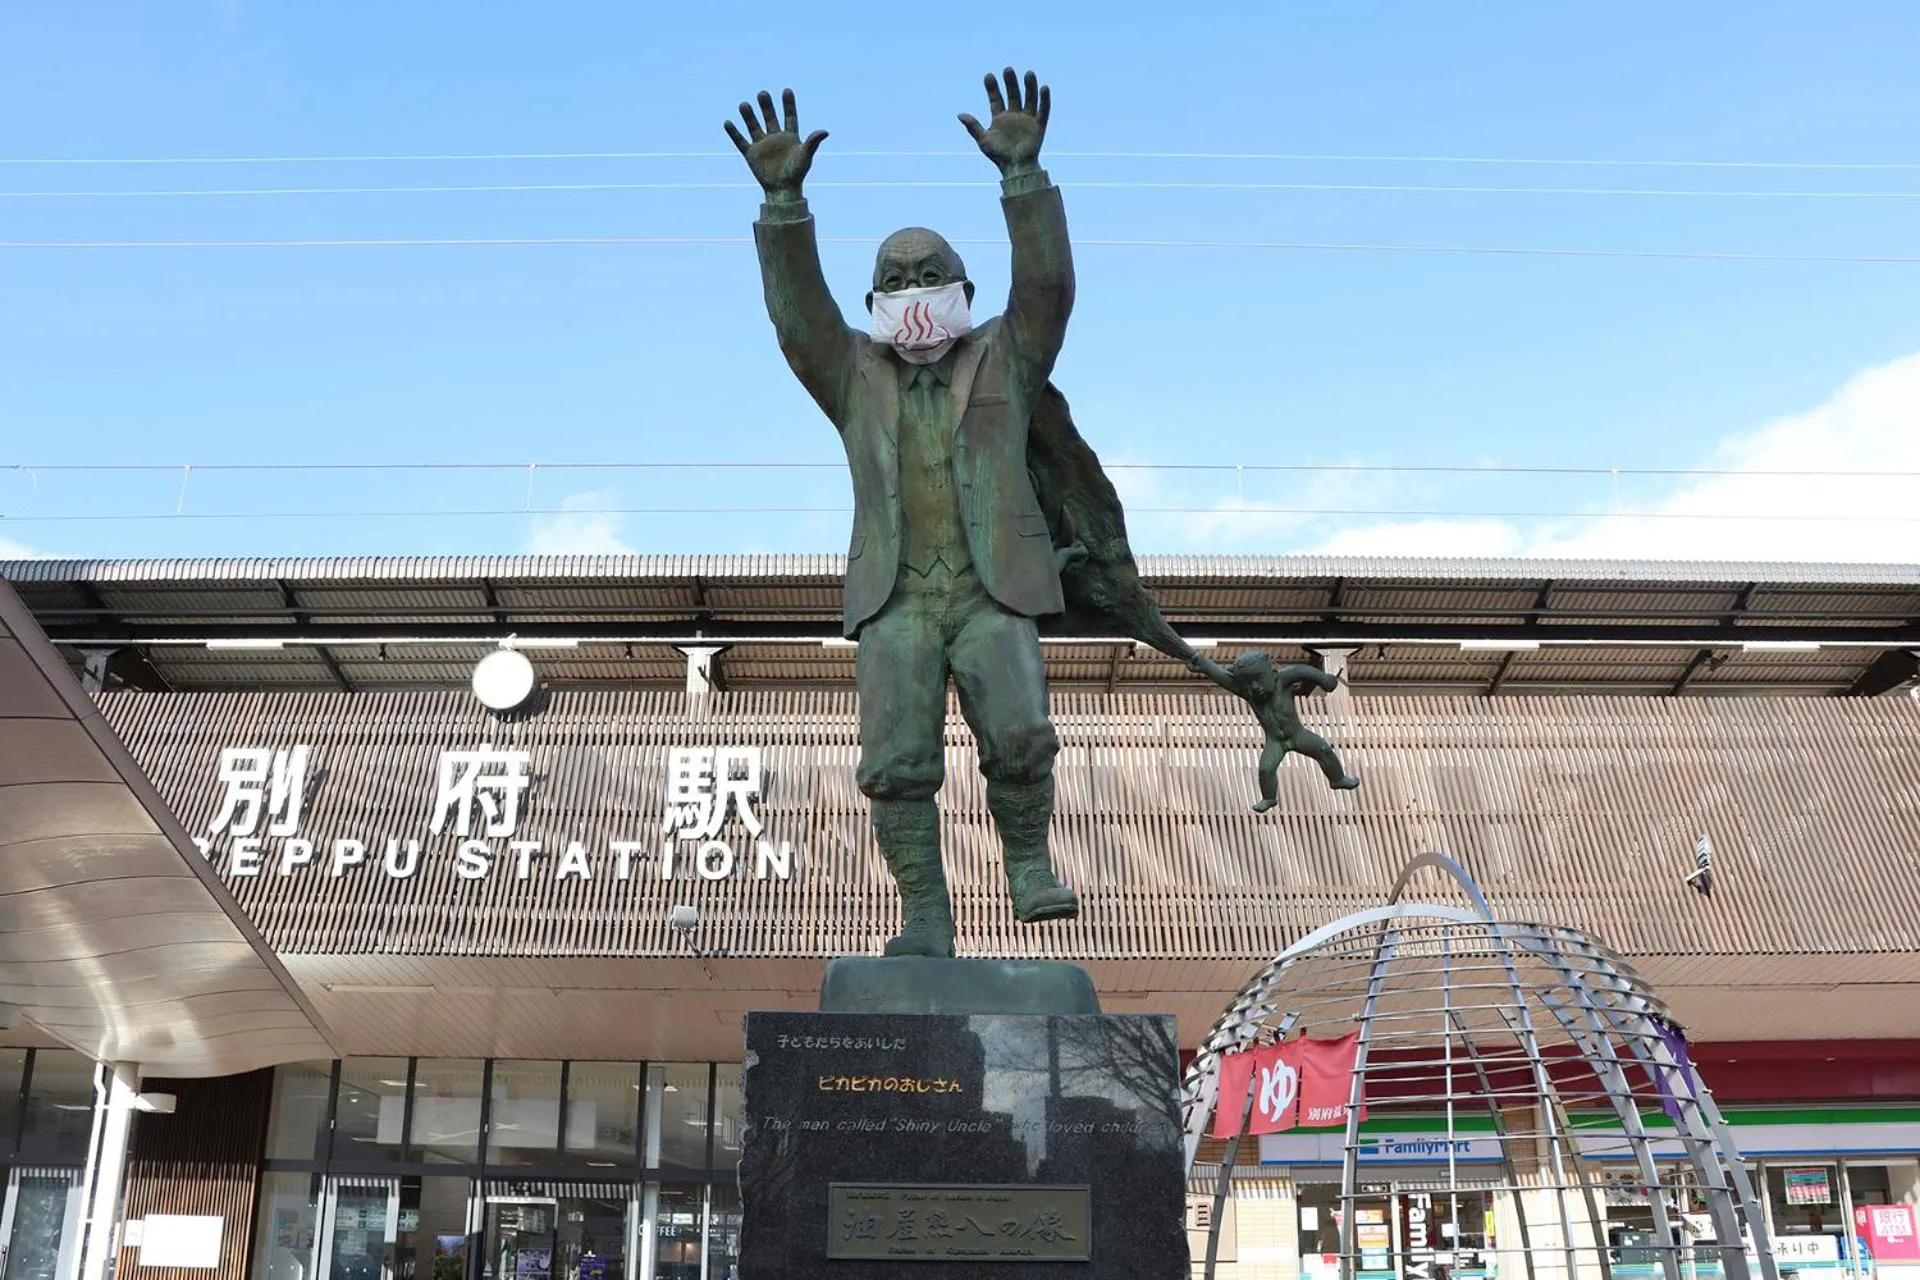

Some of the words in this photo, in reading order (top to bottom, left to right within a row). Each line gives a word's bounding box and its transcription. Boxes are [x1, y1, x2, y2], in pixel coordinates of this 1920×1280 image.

[210, 744, 764, 839] 別府駅
[457, 838, 792, 880] STATION
[1259, 1059, 1297, 1123] ゆ
[763, 1115, 792, 1130] The
[799, 1119, 830, 1131] man
[837, 1117, 886, 1131] called
[1048, 1119, 1095, 1133] loved
